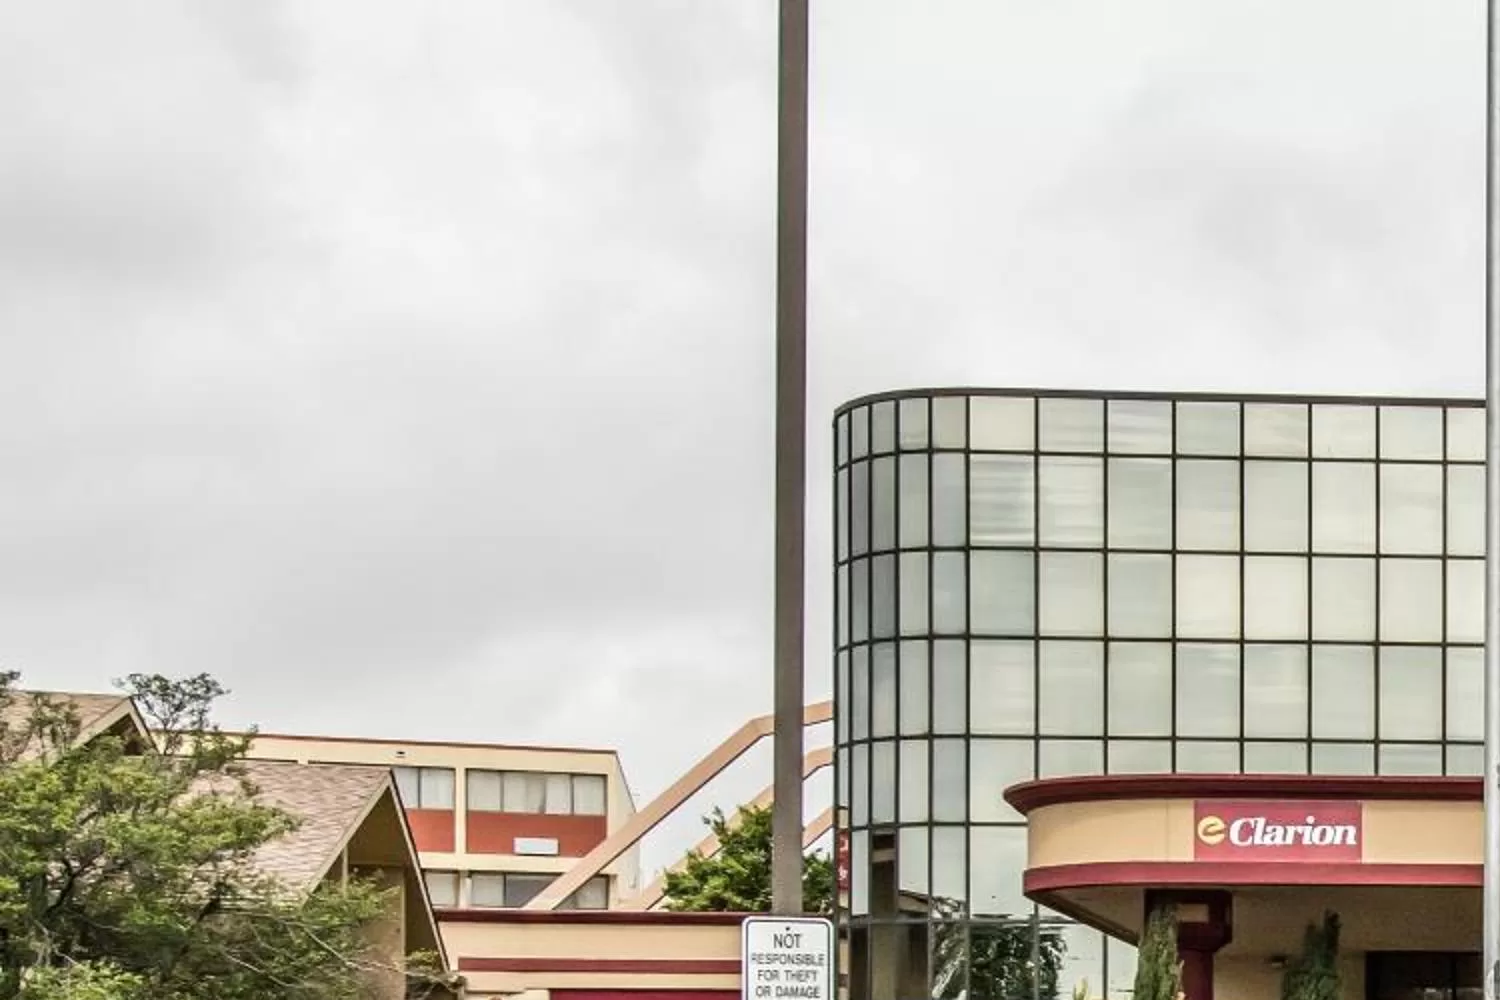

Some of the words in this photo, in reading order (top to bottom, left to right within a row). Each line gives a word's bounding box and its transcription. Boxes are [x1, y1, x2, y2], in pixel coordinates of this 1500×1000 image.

[1229, 815, 1357, 846] Clarion
[773, 933, 801, 949] NOT
[751, 953, 825, 966] RESPONSIBLE
[757, 969, 780, 981] FOR
[784, 969, 818, 982] THEFT
[755, 985, 771, 998] OR
[775, 985, 821, 999] DAMAGE
